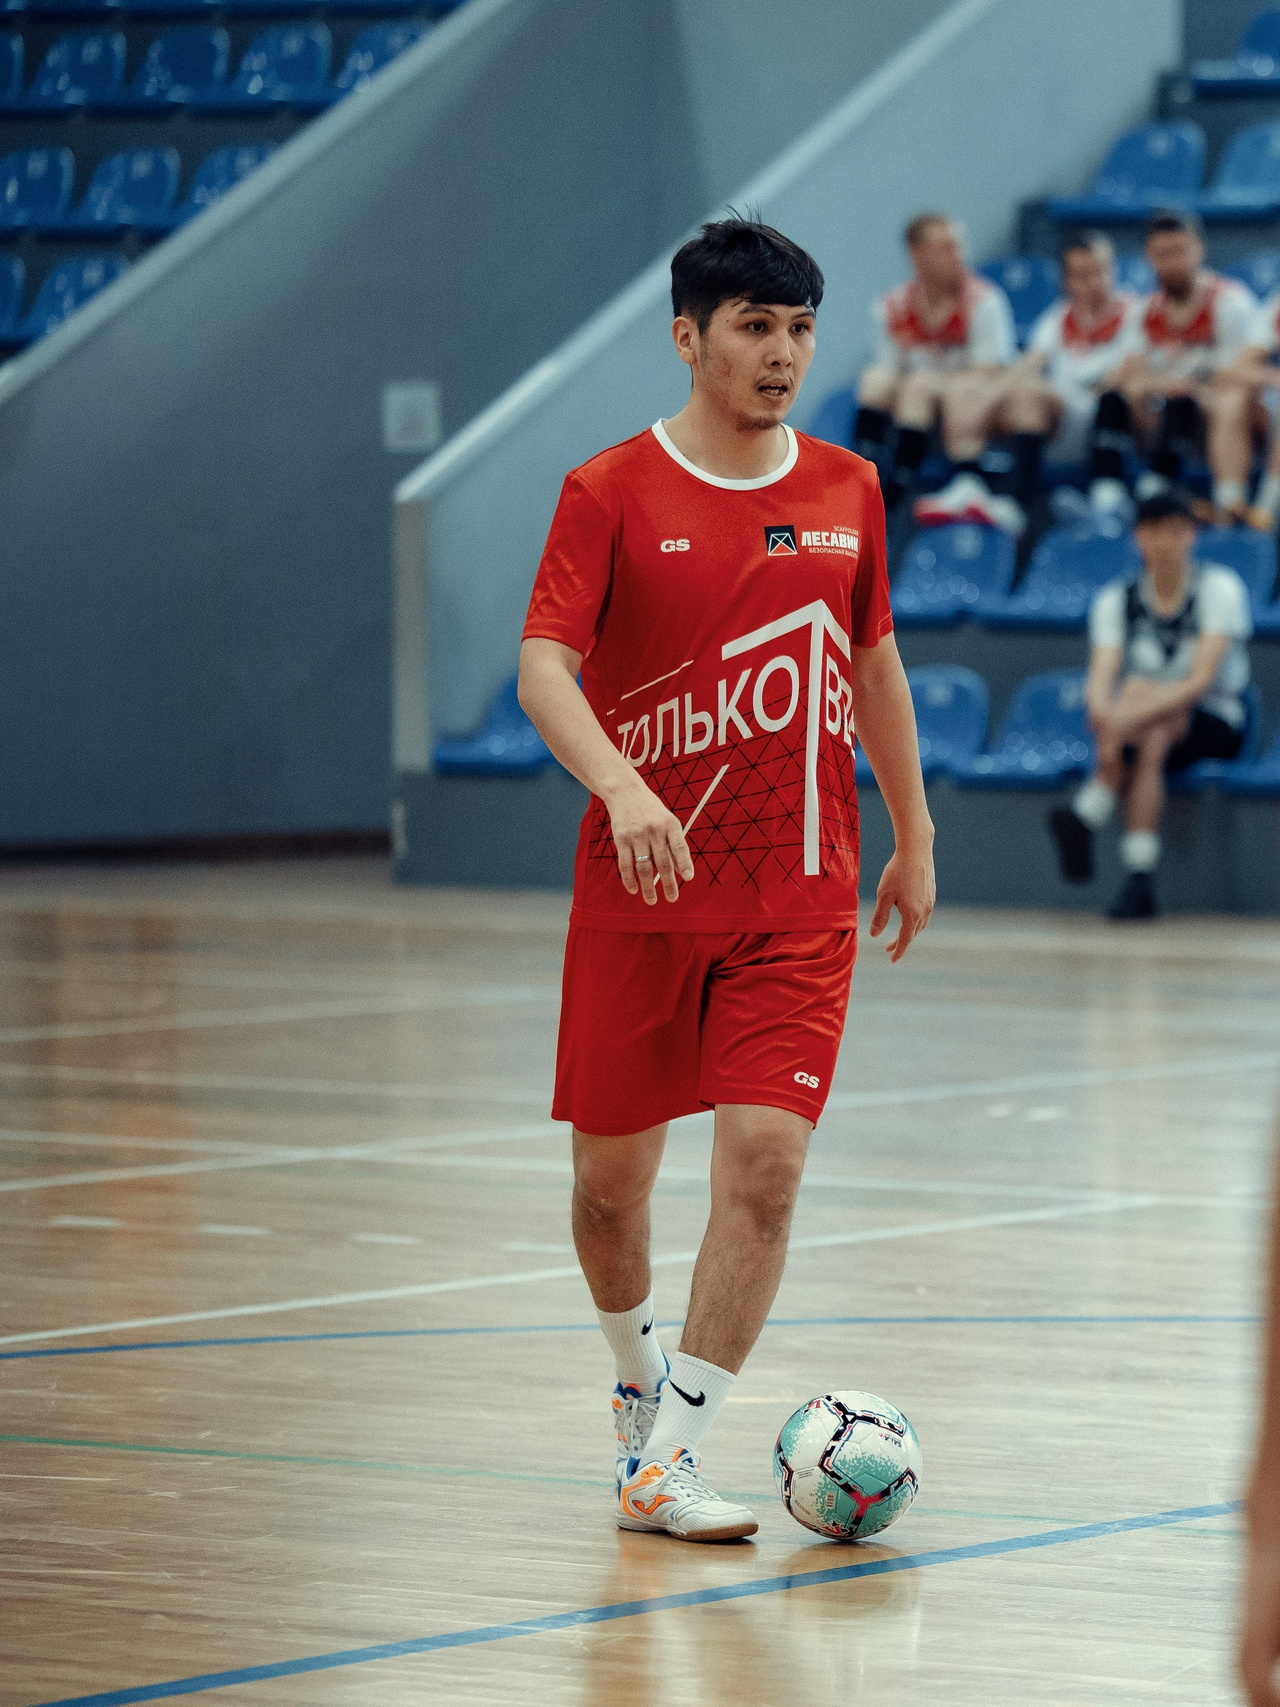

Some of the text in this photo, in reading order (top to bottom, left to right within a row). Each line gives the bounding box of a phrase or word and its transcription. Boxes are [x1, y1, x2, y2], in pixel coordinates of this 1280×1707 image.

[660, 538, 690, 553] GS
[801, 531, 859, 552] ЛЕСАВИК
[617, 655, 799, 768] ТОЛЬКО
[793, 1071, 820, 1089] GS
